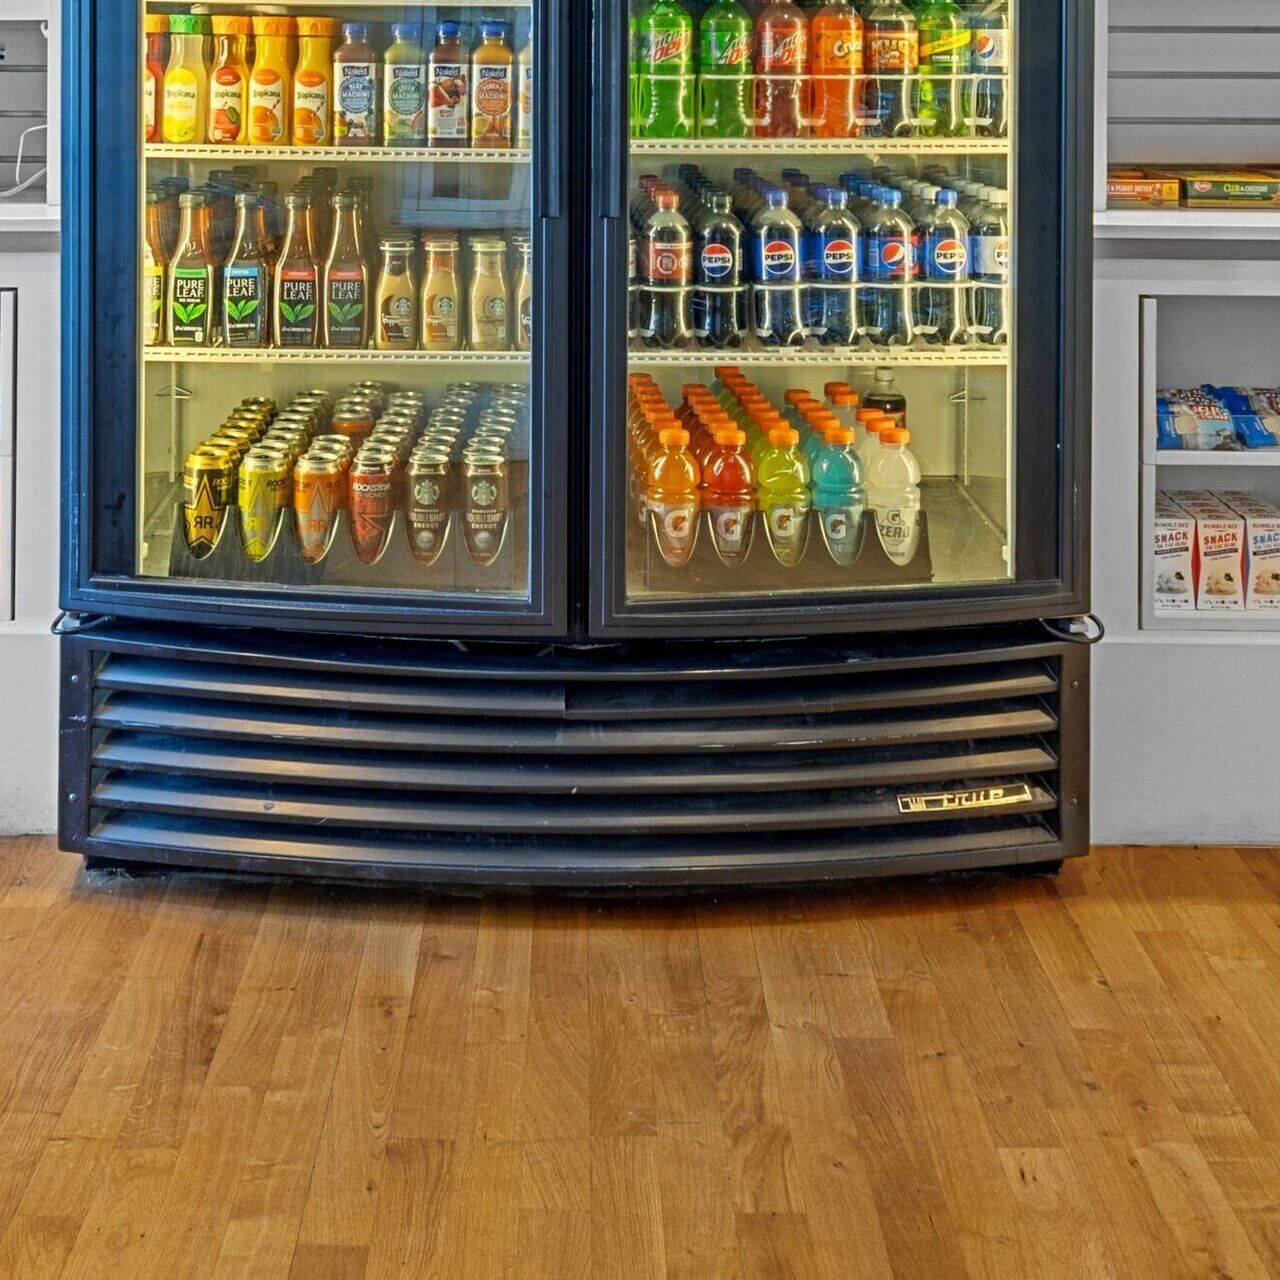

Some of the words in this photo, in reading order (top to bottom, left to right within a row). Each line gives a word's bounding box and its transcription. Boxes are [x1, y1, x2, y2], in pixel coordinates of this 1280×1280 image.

[344, 67, 368, 77] Naked
[395, 69, 418, 78] Naked
[435, 68, 460, 77] Naked
[481, 69, 506, 78] Naked
[166, 90, 196, 100] Tropicana
[214, 90, 242, 100] Tropicana
[253, 90, 281, 99] Tropicana
[297, 91, 326, 101] Tropicana
[703, 256, 731, 264] PEPSI
[765, 253, 793, 261] PEPSI
[936, 252, 965, 260] PEPSI
[177, 279, 204, 289] PURE
[227, 278, 255, 288] PURE
[284, 282, 312, 291] PURE
[332, 282, 361, 291] PURE
[352, 483, 391, 491] ROCKSTAR
[663, 509, 691, 538] G
[716, 511, 742, 541] G
[771, 508, 794, 537] G
[826, 512, 847, 540] G
[880, 524, 910, 539] ZERO
[1154, 532, 1189, 544] SNACK
[1203, 532, 1238, 544] SNACK
[942, 788, 1004, 807] true
